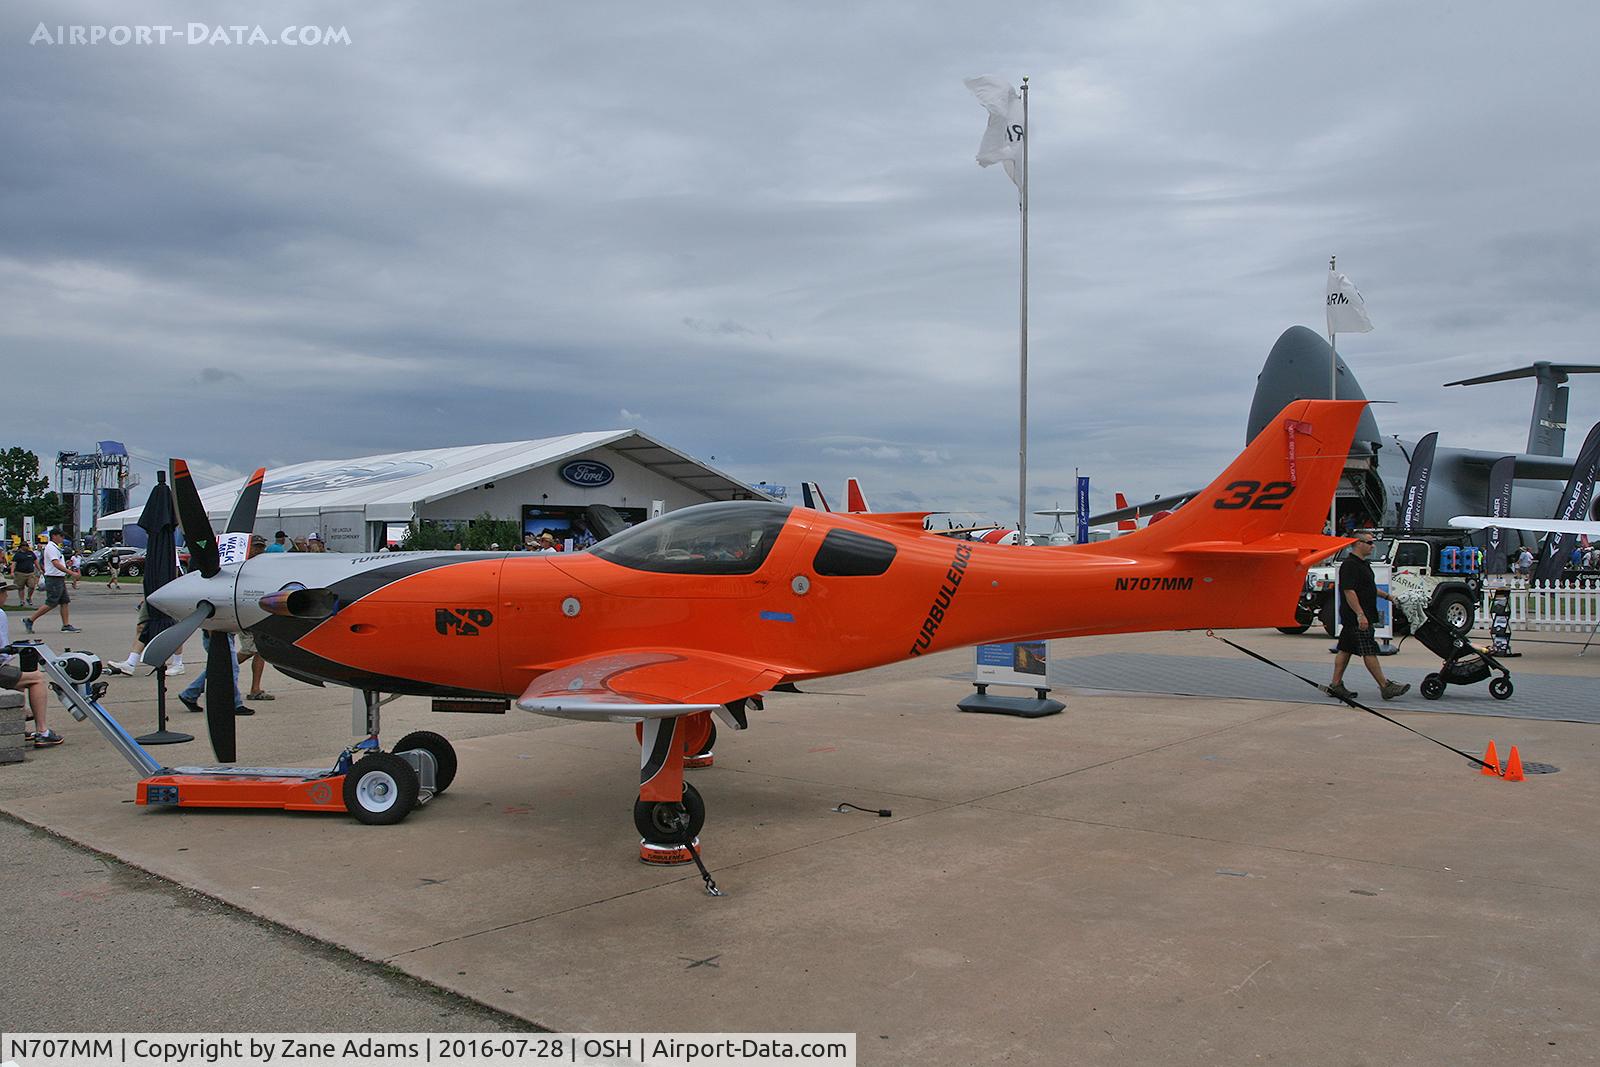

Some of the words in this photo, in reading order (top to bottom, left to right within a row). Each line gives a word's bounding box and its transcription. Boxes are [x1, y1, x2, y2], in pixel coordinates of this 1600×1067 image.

[574, 464, 604, 481] Ford
[1213, 480, 1297, 509] 32
[1412, 482, 1424, 523] Executive
[224, 536, 238, 563] WALK
[1115, 577, 1194, 591] N707MM
[909, 543, 973, 657] TURBULENCE
